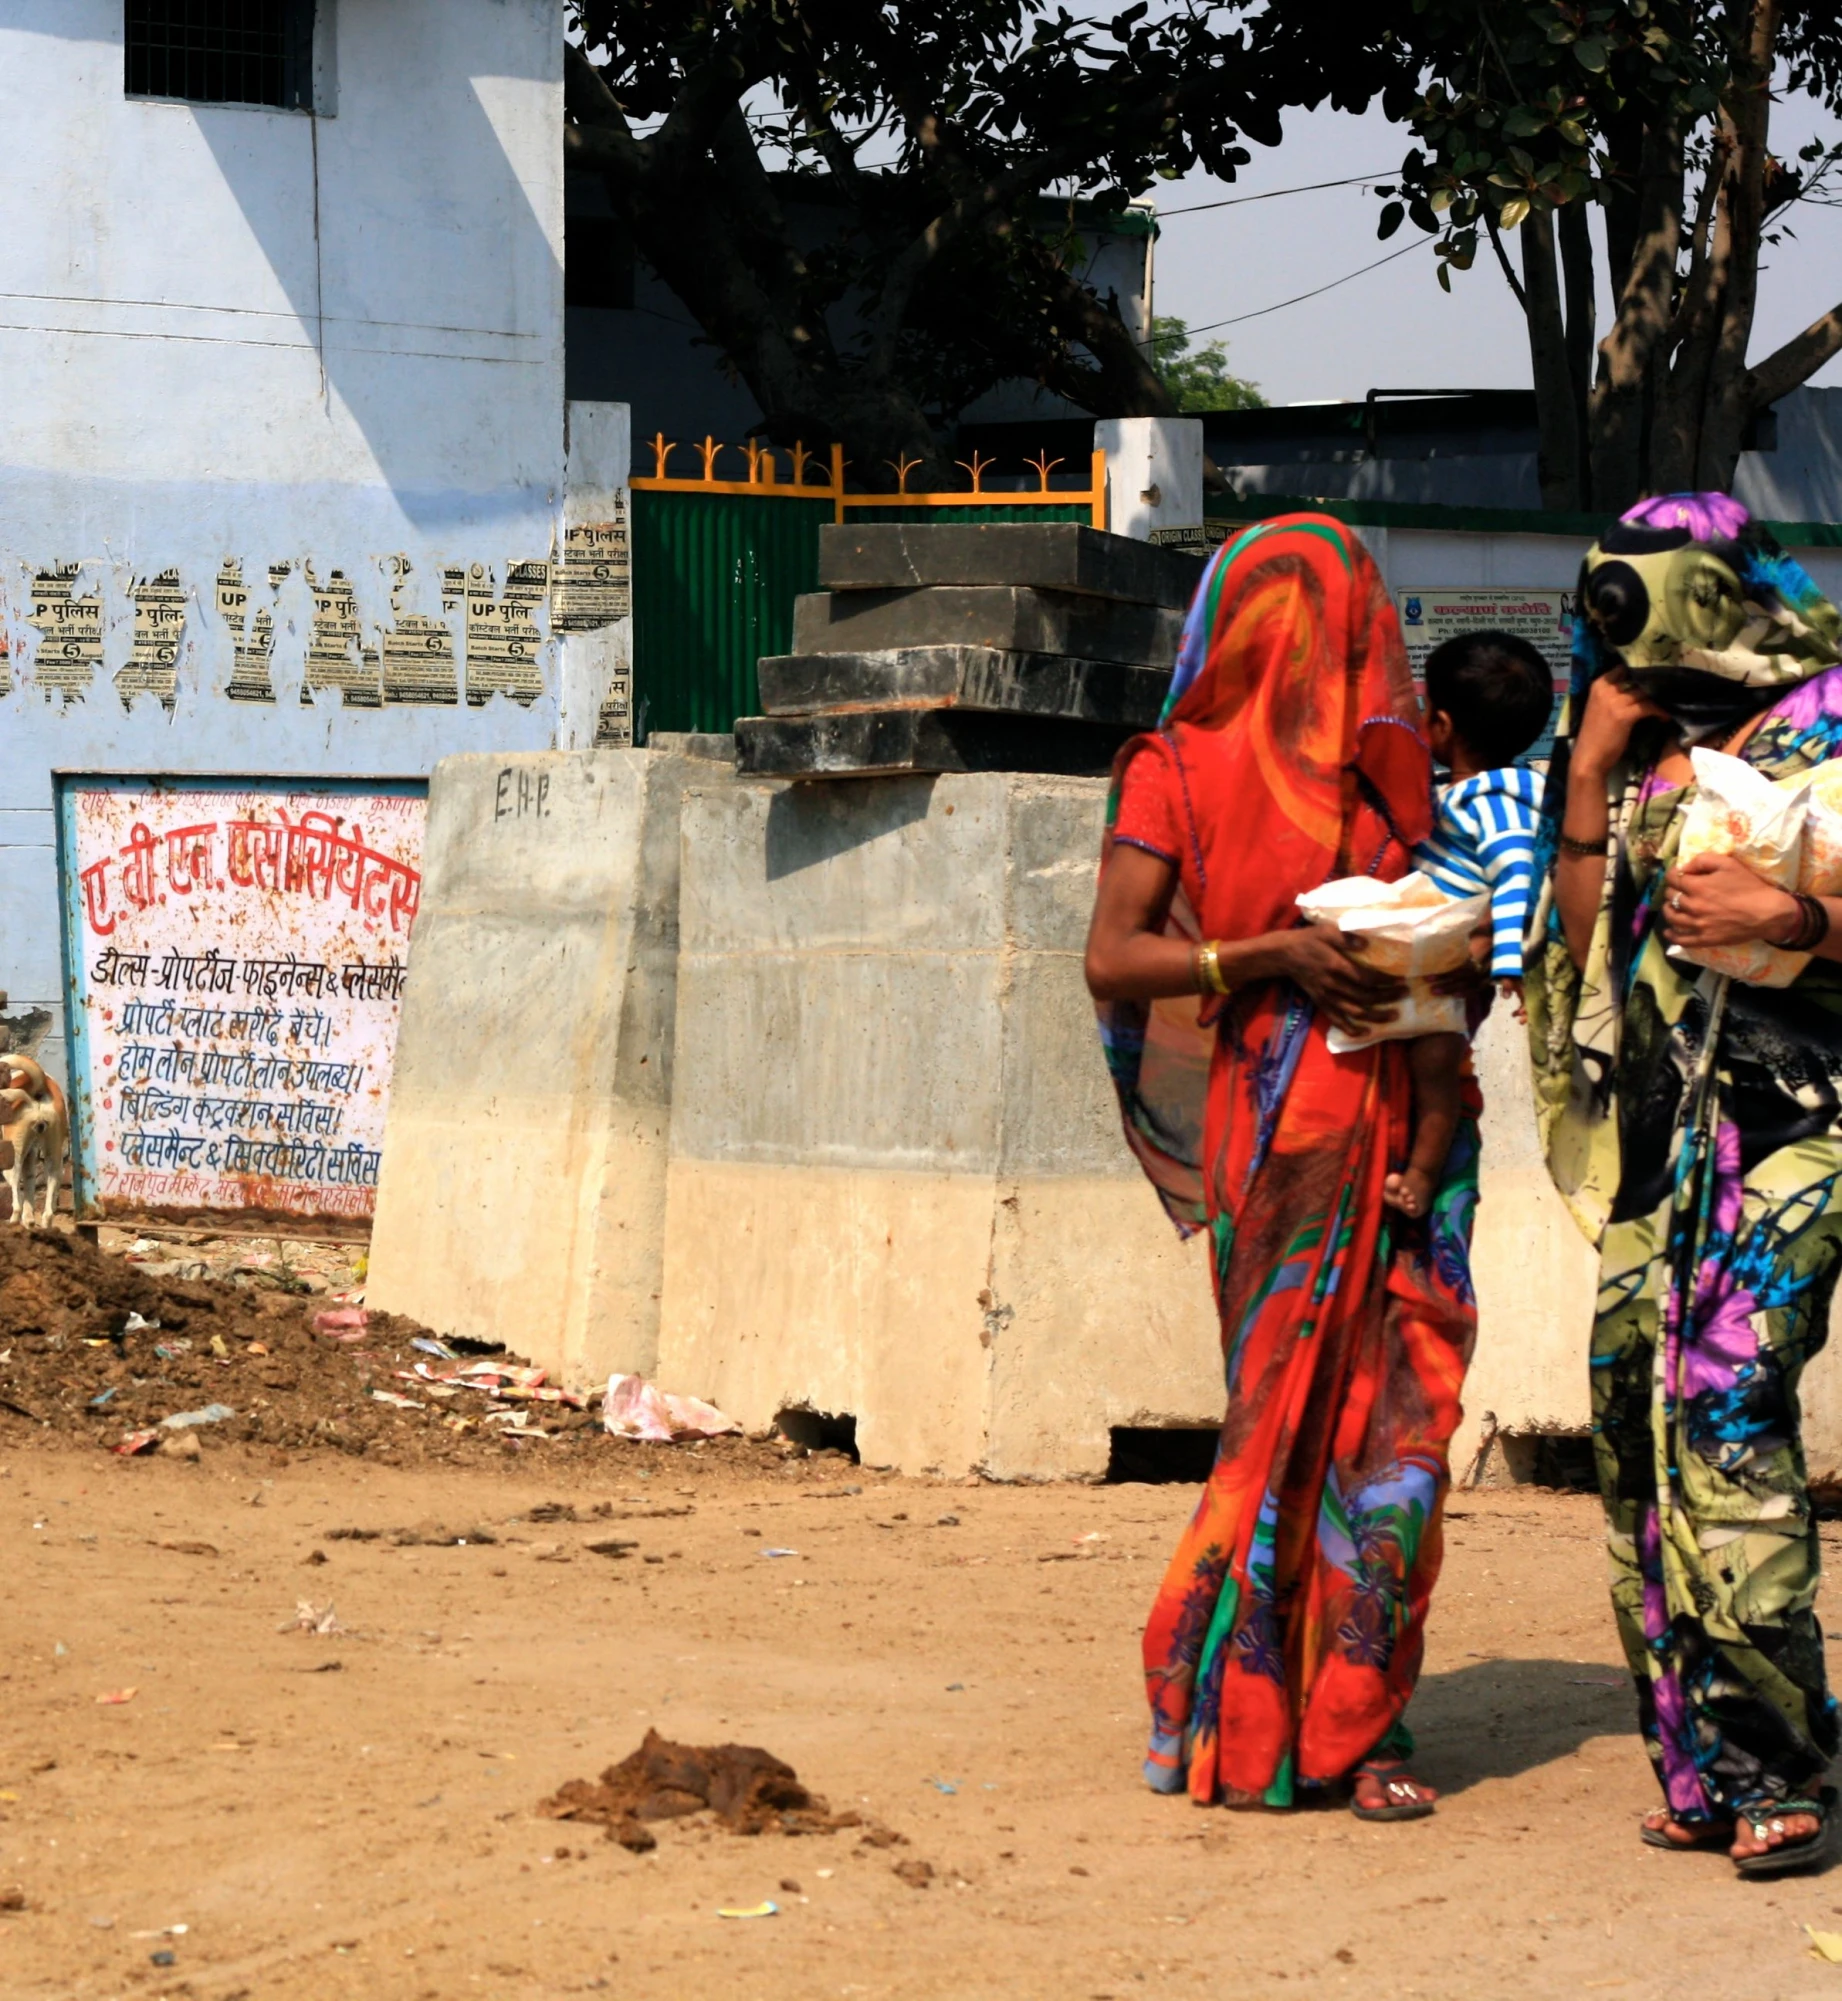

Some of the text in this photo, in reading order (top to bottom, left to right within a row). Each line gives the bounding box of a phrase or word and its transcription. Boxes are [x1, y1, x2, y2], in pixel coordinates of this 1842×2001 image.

[595, 566, 608, 579] 5
[221, 592, 246, 606] UP
[34, 599, 99, 623] P पुलिस
[147, 604, 184, 628] पुलि
[472, 603, 496, 617] UP
[499, 600, 533, 623] पुलि
[58, 623, 75, 635] भर्ती
[504, 623, 519, 635] भर्ती
[65, 644, 79, 658] 5
[159, 648, 173, 661] 5
[428, 638, 441, 651] 5
[510, 643, 523, 656] 5
[326, 971, 339, 997] &
[114, 997, 176, 1036] प्रोपर्टी
[180, 1007, 226, 1038] प्लाट
[118, 1040, 156, 1081] होम
[156, 1041, 199, 1084] लोन
[254, 1052, 293, 1089] लोन
[120, 1085, 192, 1124] बिल्डिंग
[120, 1126, 207, 1170] प्लेसमैन्ट
[206, 1142, 221, 1171] &
[327, 1142, 382, 1186] सर्विस
[104, 1171, 118, 1191] 7
